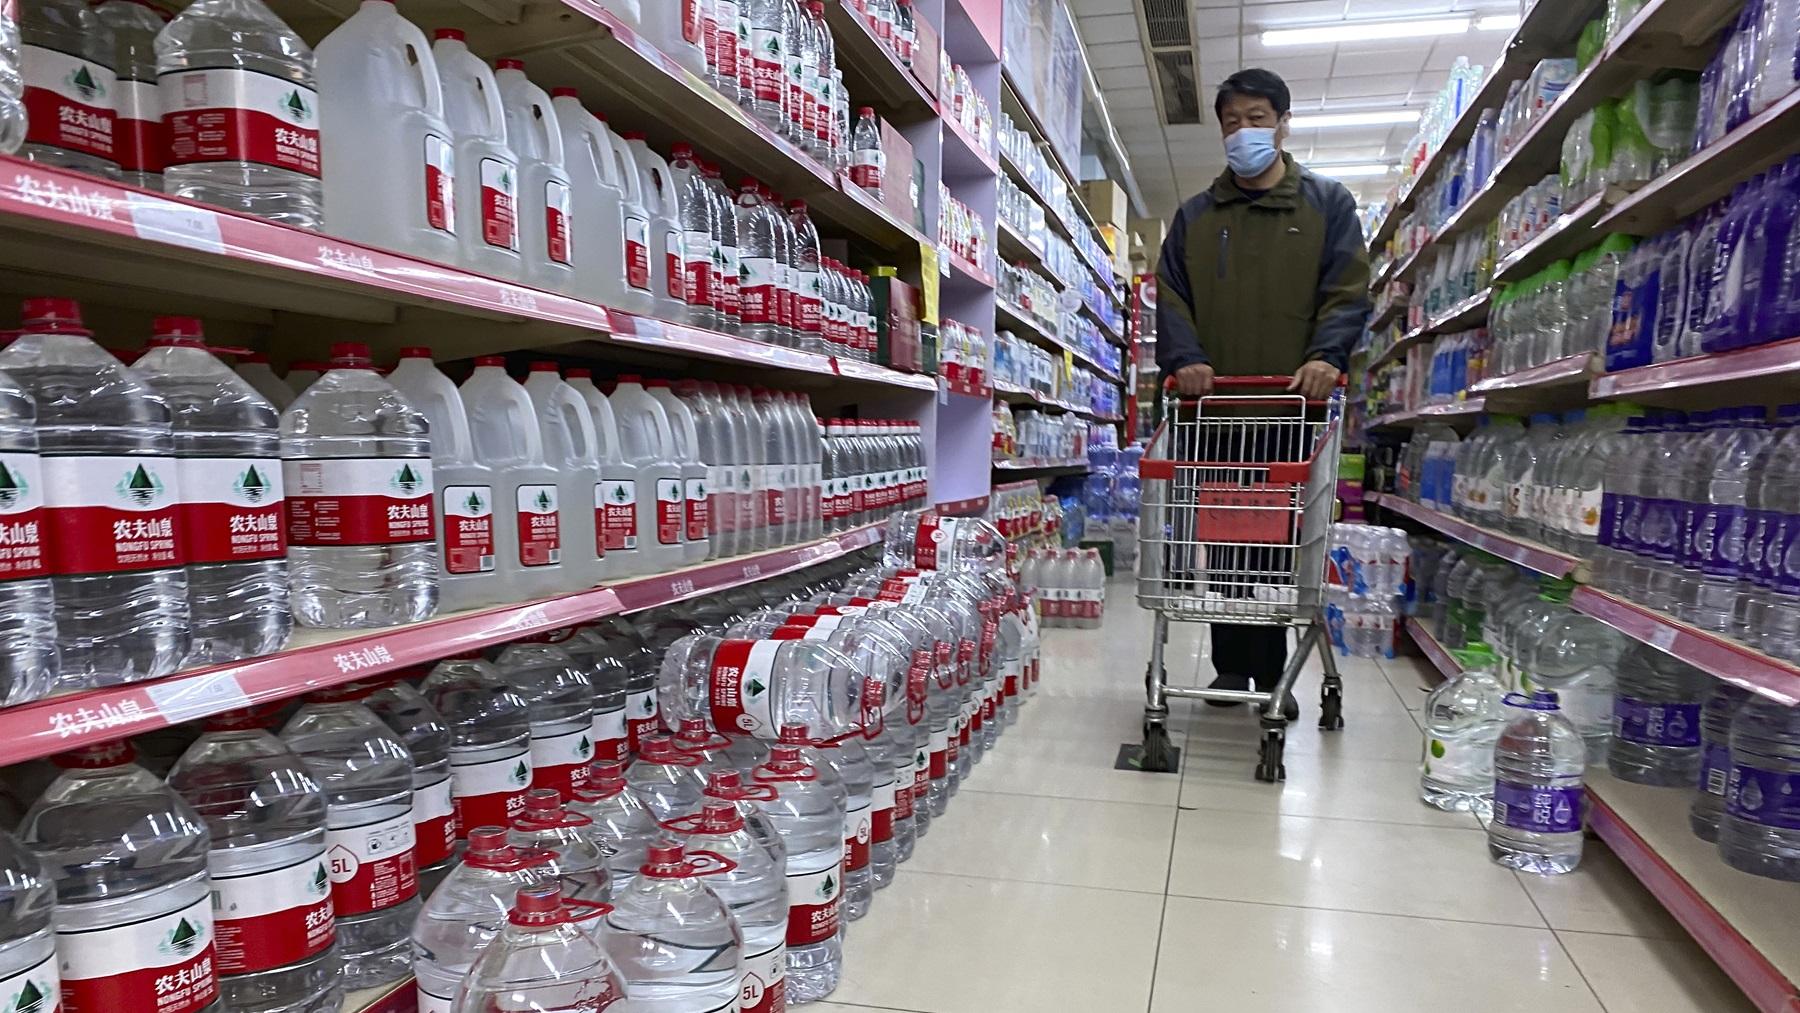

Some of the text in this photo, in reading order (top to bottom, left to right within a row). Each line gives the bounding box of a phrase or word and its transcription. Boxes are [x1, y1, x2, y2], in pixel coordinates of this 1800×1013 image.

[387, 504, 429, 520] 农夫山泉
[113, 518, 173, 540] 农夫山泉
[229, 513, 278, 533] 农夫山泉
[333, 645, 394, 674] 农夫山泉
[49, 698, 144, 738] 农夫山泉
[331, 858, 351, 874] 5L
[154, 957, 212, 995] 农夫山泉
[743, 985, 759, 1000] 5L
